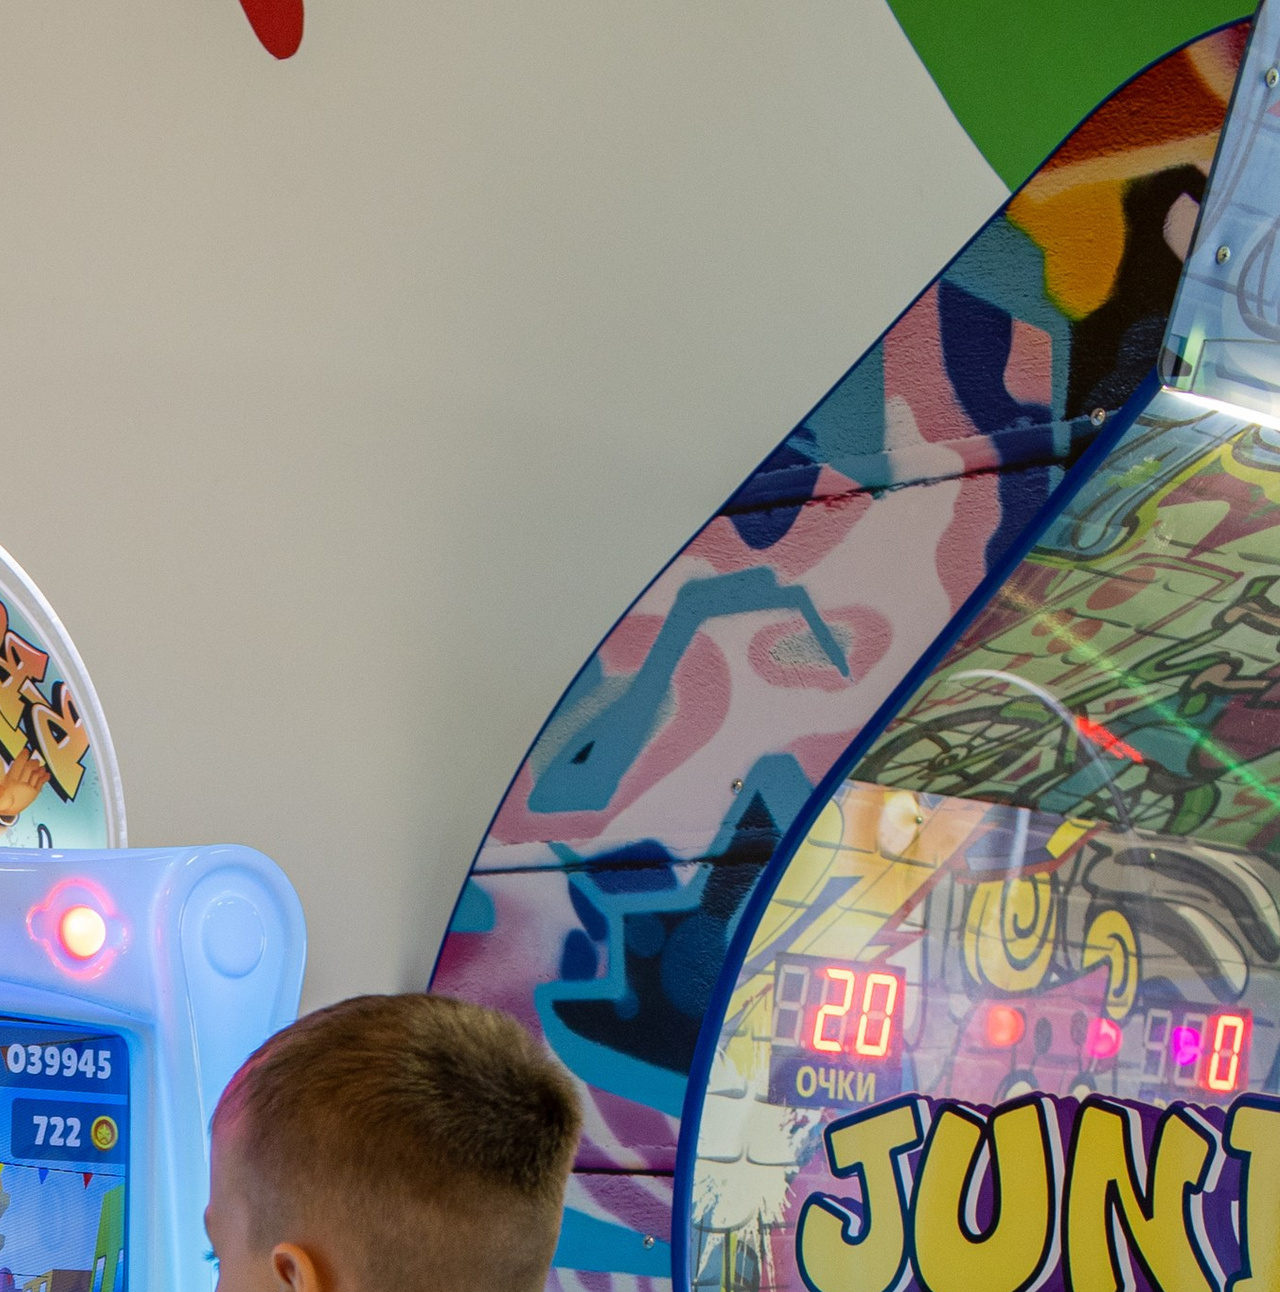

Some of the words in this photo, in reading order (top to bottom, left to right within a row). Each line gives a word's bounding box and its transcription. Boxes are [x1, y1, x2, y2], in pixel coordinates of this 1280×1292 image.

[812, 967, 898, 1057] 20
[6, 1043, 112, 1080] 039945
[795, 1065, 876, 1103] ОЧКИ
[32, 1115, 82, 1148] 722
